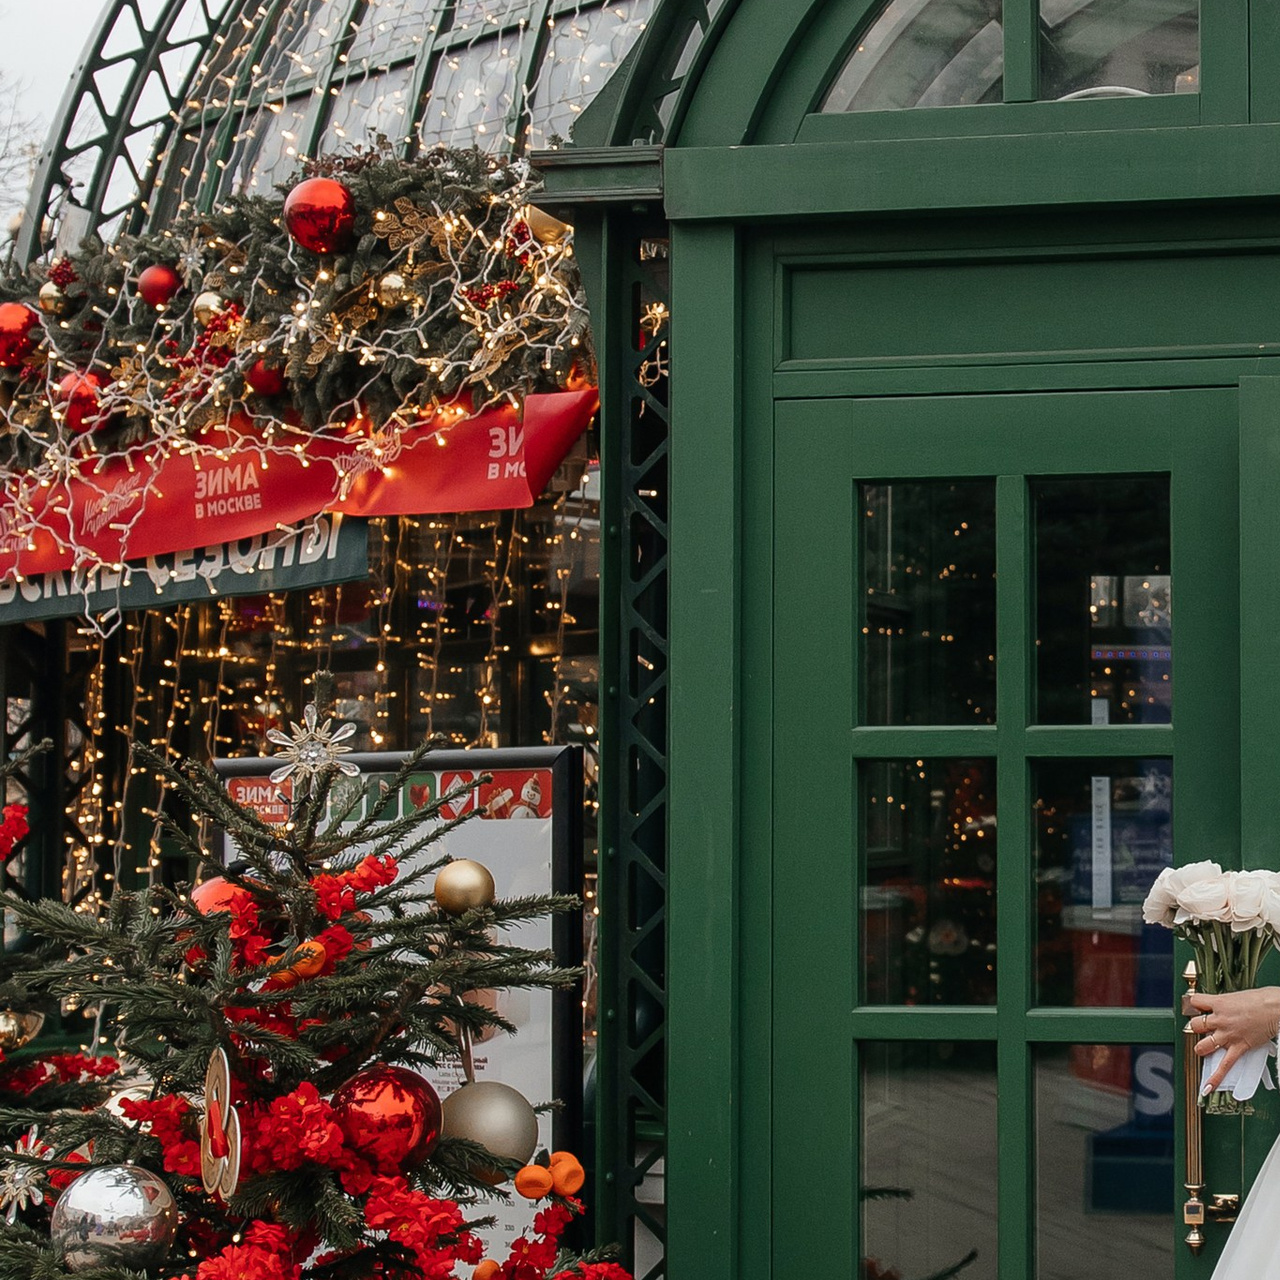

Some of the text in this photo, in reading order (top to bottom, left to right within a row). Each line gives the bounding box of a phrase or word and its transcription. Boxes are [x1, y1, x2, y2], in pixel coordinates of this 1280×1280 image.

[194, 461, 260, 499] ЗИМА
[487, 462, 500, 480] В
[195, 493, 262, 520] В МОСКВЕ
